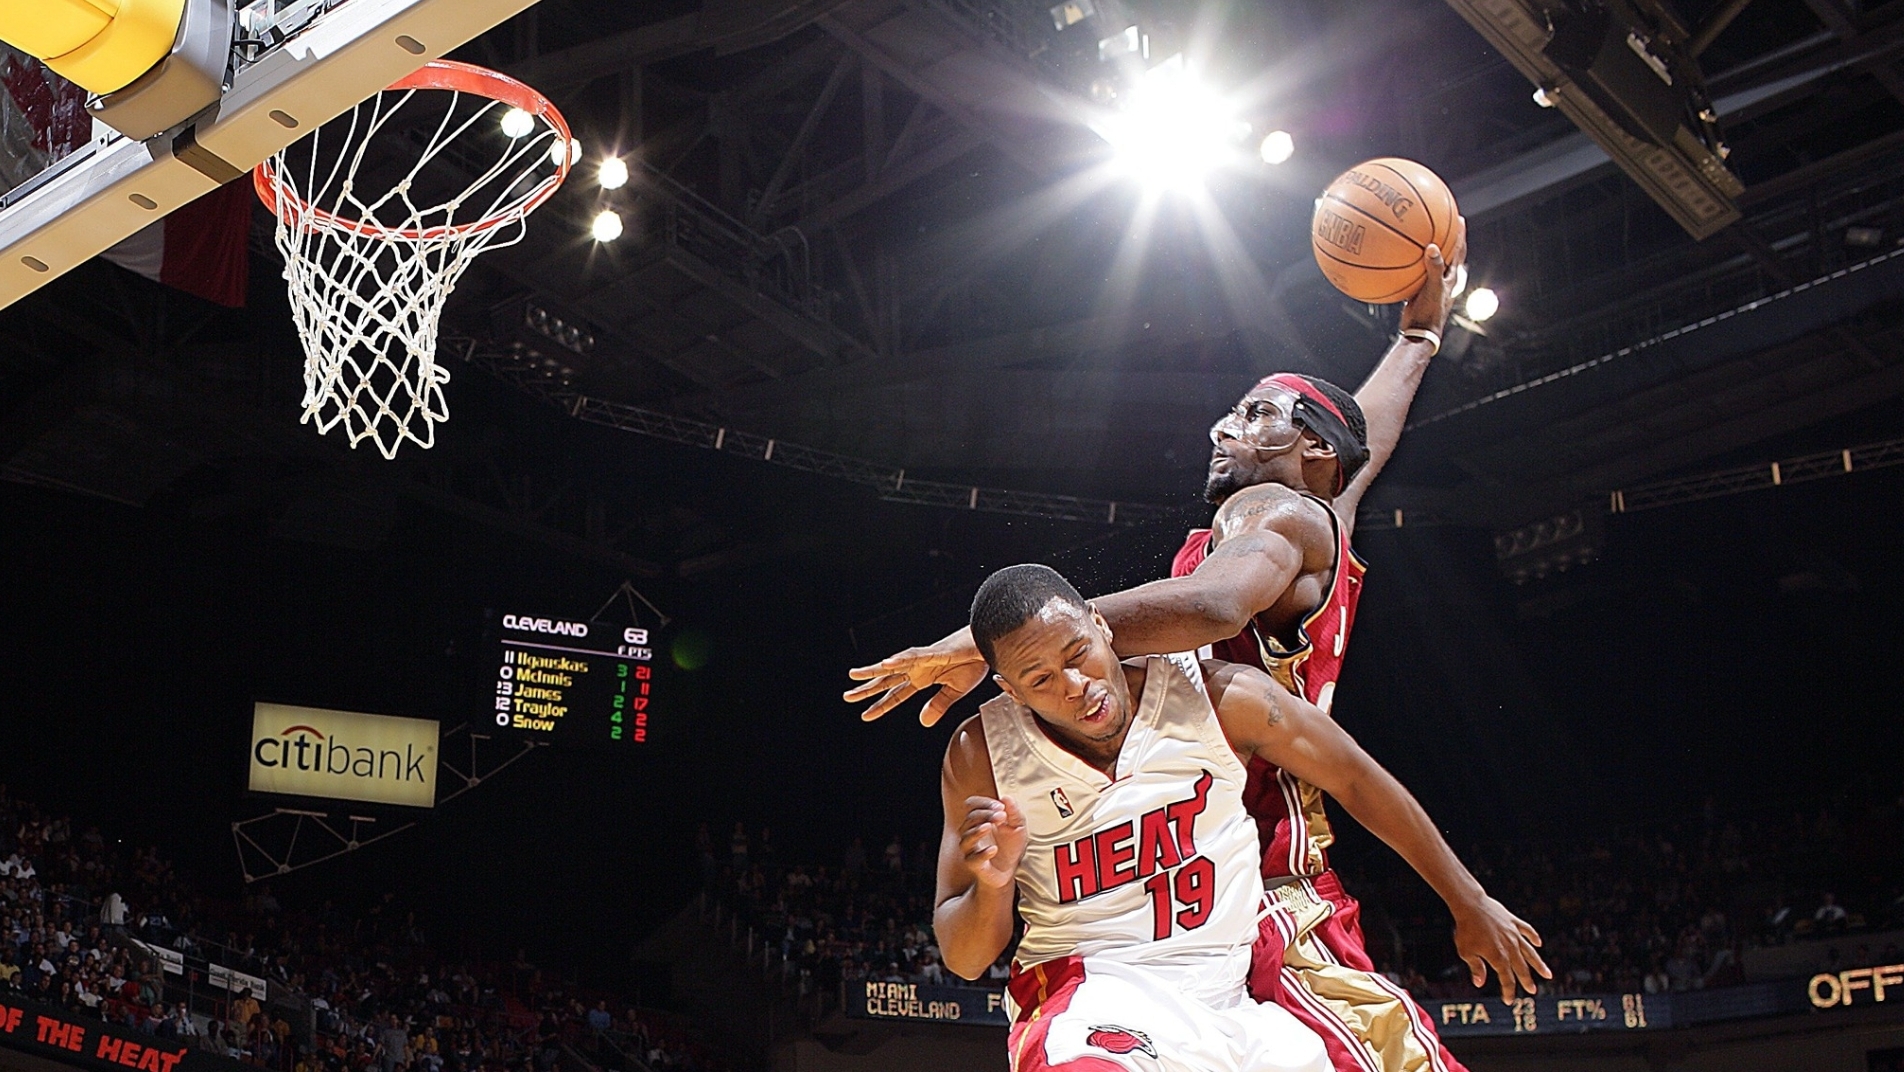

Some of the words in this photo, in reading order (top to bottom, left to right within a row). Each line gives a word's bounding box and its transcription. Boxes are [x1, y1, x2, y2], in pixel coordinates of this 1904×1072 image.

[503, 614, 588, 637] CLEVELAND
[500, 666, 513, 679] 0
[516, 667, 573, 687] McInnis
[517, 652, 589, 673] Ilgauskas
[616, 664, 628, 678] 3
[635, 666, 651, 679] 21
[514, 683, 562, 701] James
[613, 695, 624, 708] 2
[633, 697, 648, 711] 17
[514, 699, 568, 718] Traylor
[610, 711, 622, 723] 4
[635, 713, 647, 727] 2
[496, 713, 509, 726] 0
[512, 715, 555, 731] Snow
[611, 726, 622, 739] 2
[634, 729, 646, 742] 2
[255, 732, 425, 783] citibank
[1053, 768, 1213, 904] HEAT
[1144, 855, 1216, 941] 19
[866, 981, 918, 1000] MIAMI
[1808, 964, 1904, 1008] OFF
[867, 998, 961, 1020] CLEVELAND
[1441, 1003, 1491, 1025] FTA
[1557, 998, 1607, 1021] FT%
[37, 1015, 85, 1052] THE
[96, 1035, 187, 1072] HEAT
